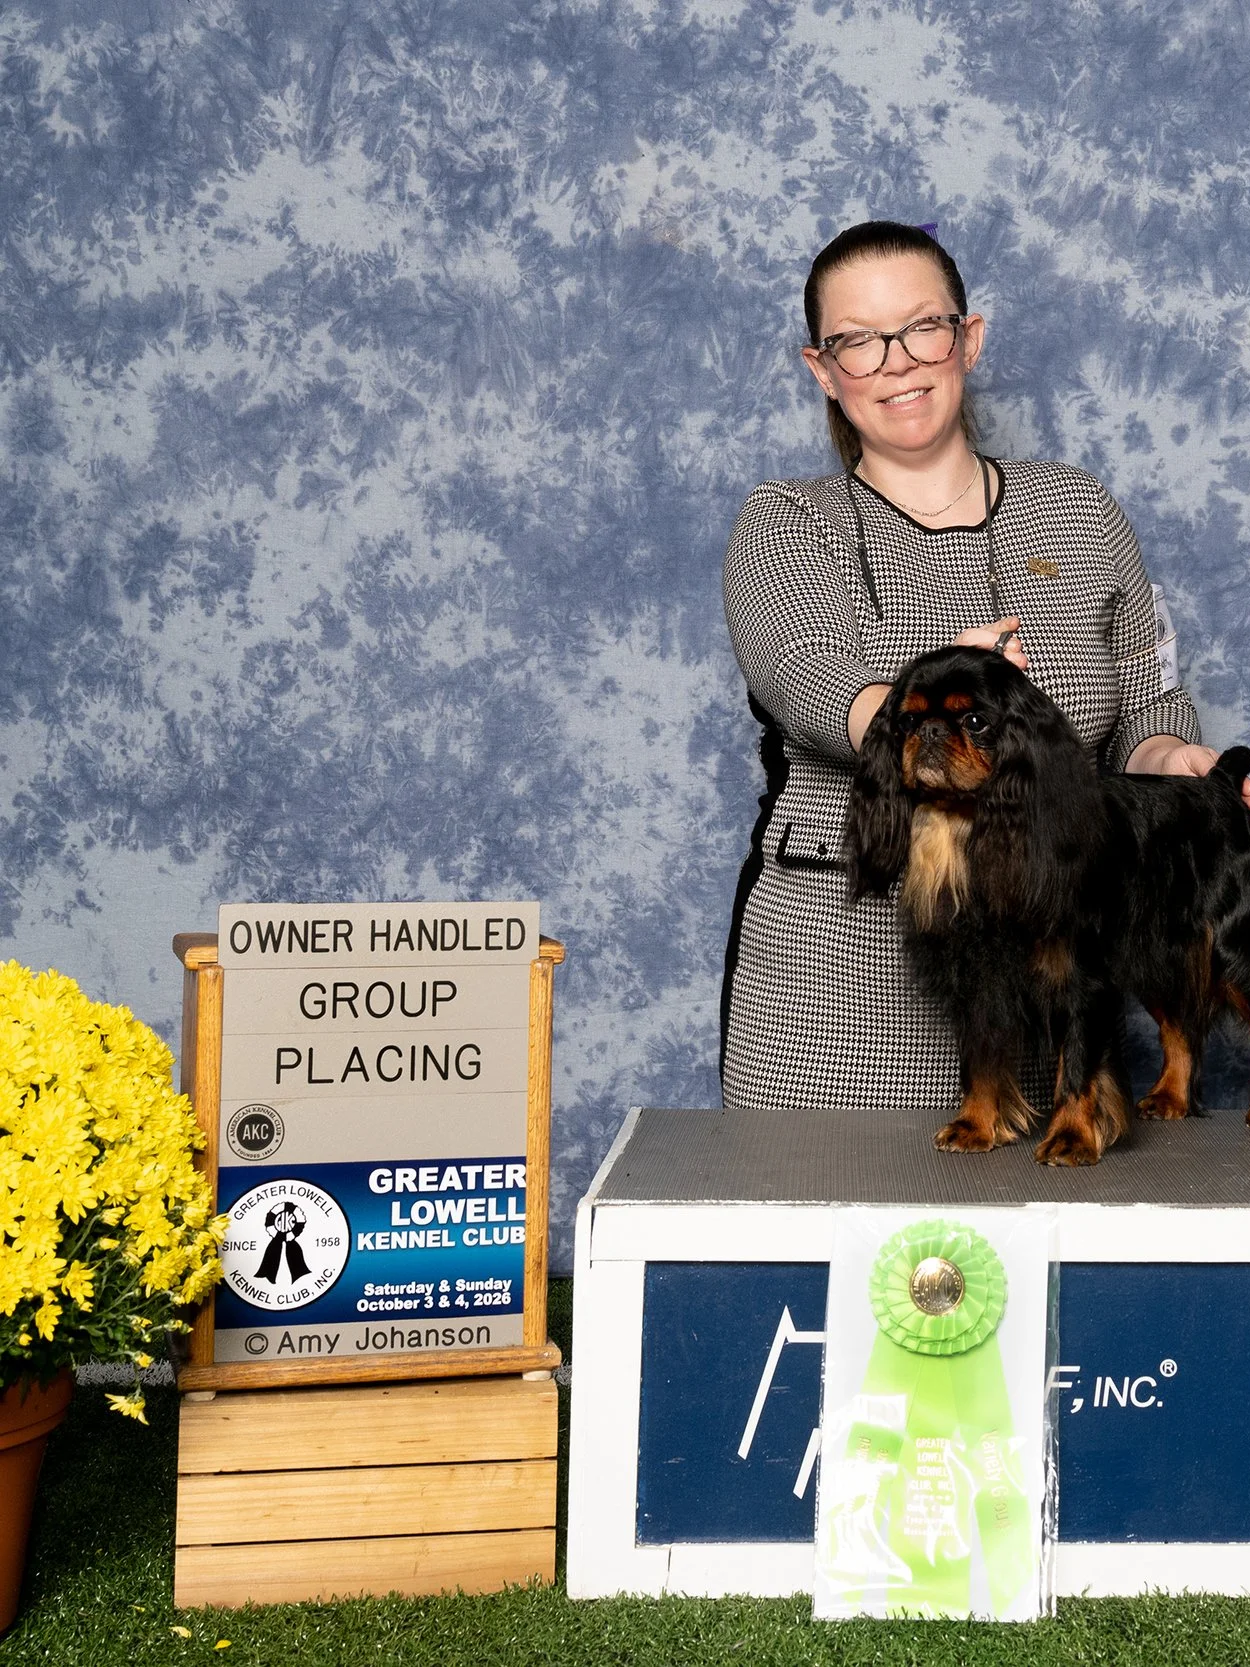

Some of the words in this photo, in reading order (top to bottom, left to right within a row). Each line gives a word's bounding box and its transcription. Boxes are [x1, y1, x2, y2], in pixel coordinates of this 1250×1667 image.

[230, 919, 353, 954] OWNER
[370, 918, 526, 952] HANDLED
[300, 981, 457, 1019] GROUP
[276, 1043, 481, 1084] PLACING
[230, 1108, 251, 1137] AMERICAN
[252, 1107, 276, 1120] KENNEL
[242, 1123, 269, 1140] AKC
[237, 1148, 260, 1158] FOUNDED
[369, 1164, 526, 1194] GREATER
[233, 1185, 286, 1220] GREATER
[290, 1185, 334, 1217] LOWELL
[391, 1197, 525, 1226] LOWELL
[221, 1241, 257, 1252] SINCE
[315, 1237, 341, 1247] 1958
[357, 1229, 456, 1250] KENNEL
[462, 1226, 525, 1246] CLUB
[229, 1269, 271, 1304] KENNEL
[277, 1288, 315, 1305] CLUB,
[314, 1268, 336, 1289] INC.
[364, 1281, 434, 1297] Saturday
[439, 1279, 450, 1292] &
[455, 1278, 512, 1292] Sunday
[356, 1297, 420, 1312] October
[424, 1296, 434, 1308] 3
[438, 1295, 450, 1308] &
[455, 1295, 470, 1310] 4,
[473, 1292, 512, 1306] 2026
[277, 1331, 340, 1354] Amy
[355, 1325, 491, 1351] Johanson
[916, 1438, 951, 1448] GREATER
